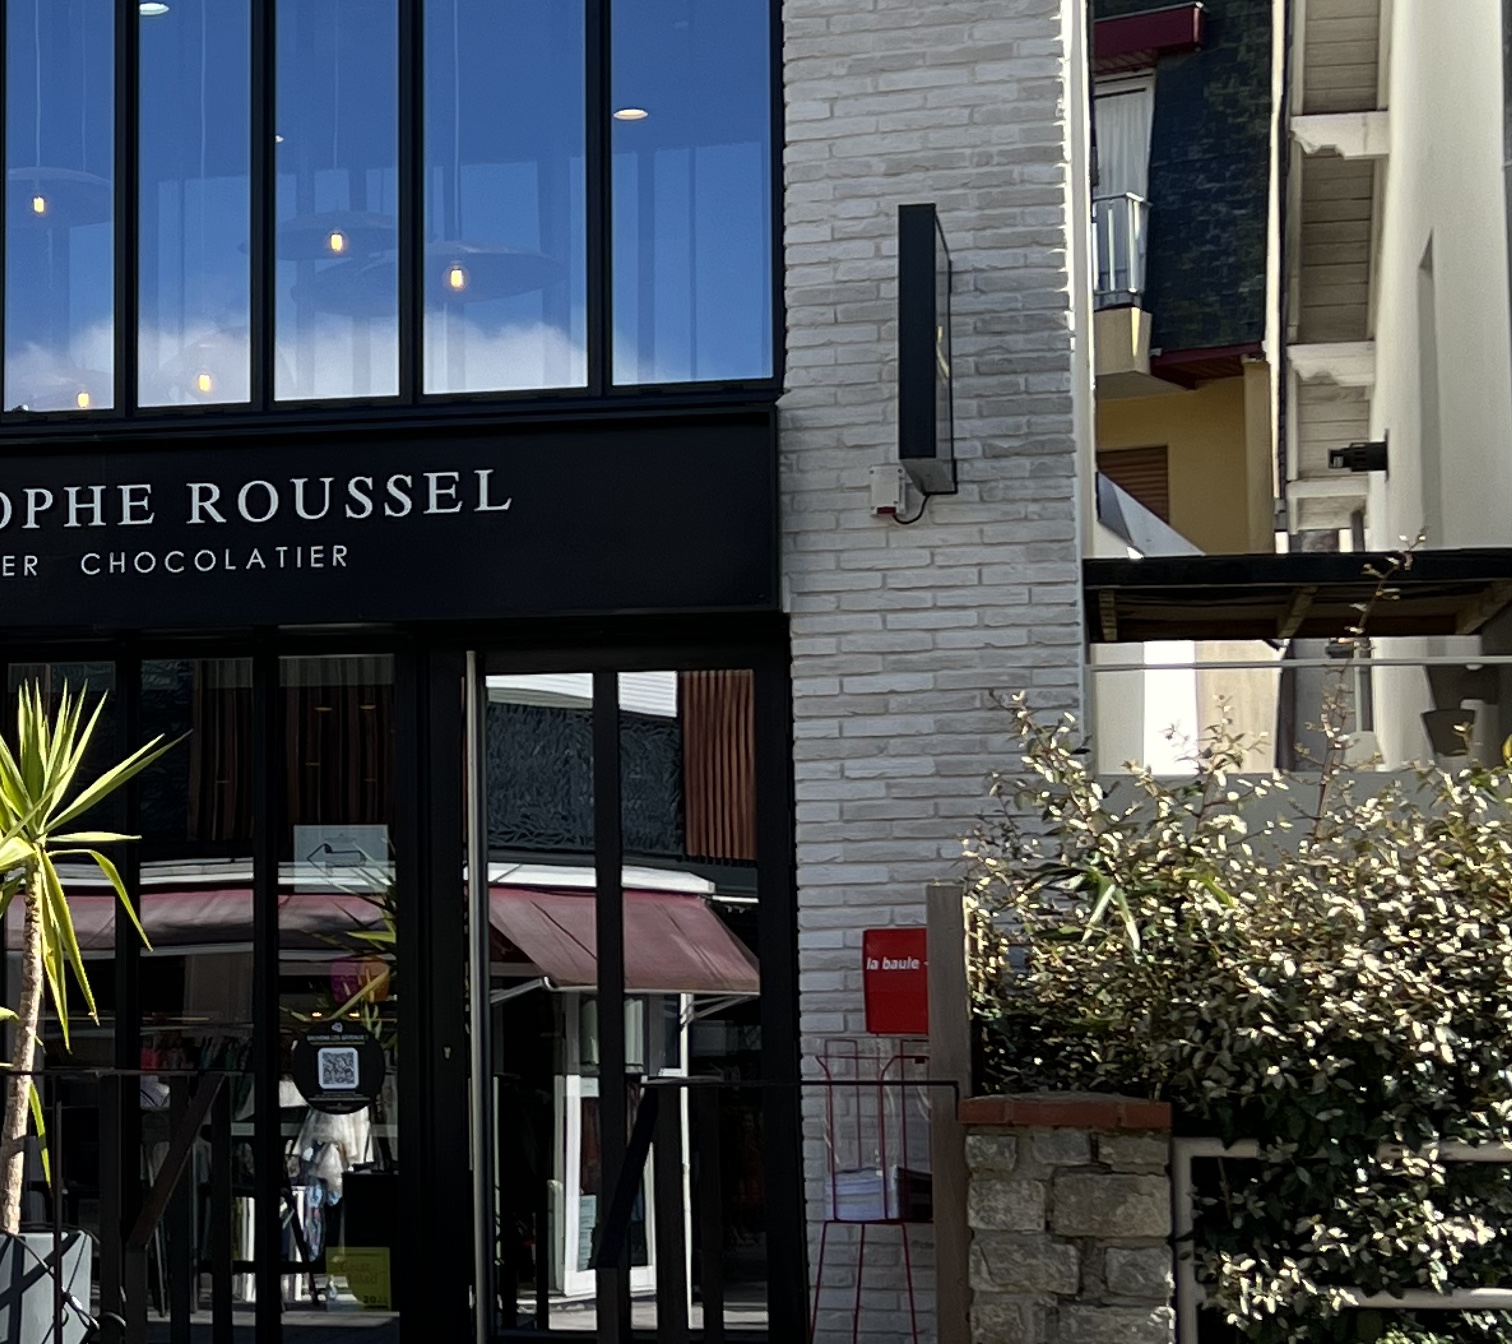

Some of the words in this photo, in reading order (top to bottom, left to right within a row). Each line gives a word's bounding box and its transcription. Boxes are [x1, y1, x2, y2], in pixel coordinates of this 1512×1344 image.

[185, 468, 512, 525] ROUSSEL
[80, 545, 348, 576] CHOCOLATIER
[866, 957, 879, 970] la
[882, 956, 920, 971] baule
